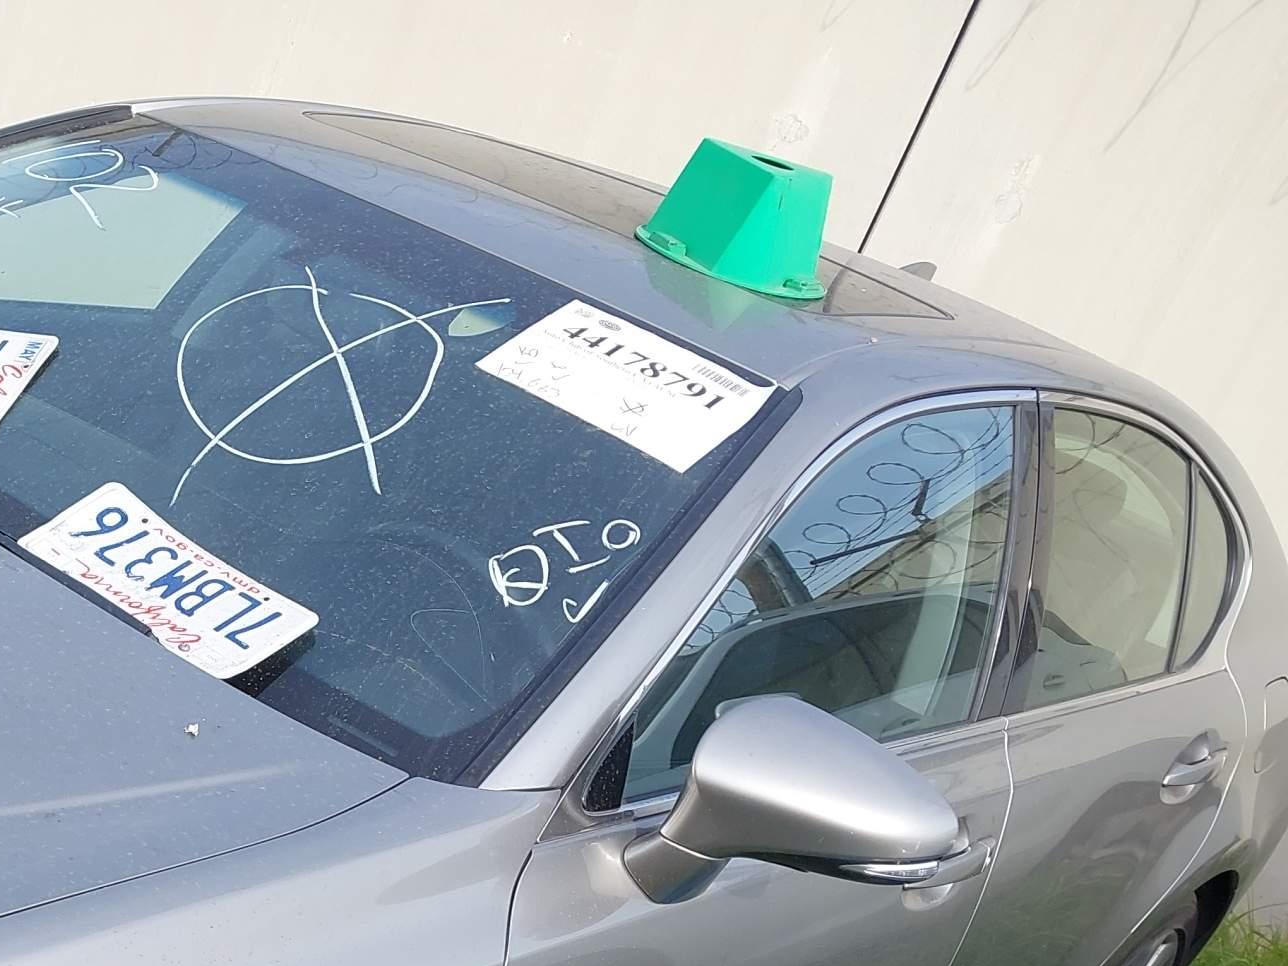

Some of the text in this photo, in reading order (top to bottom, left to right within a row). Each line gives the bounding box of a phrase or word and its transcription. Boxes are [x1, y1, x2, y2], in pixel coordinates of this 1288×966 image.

[18, 340, 44, 362] MAY
[563, 326, 726, 410] 44178791
[69, 506, 283, 650] 7LBM376
[75, 557, 203, 647] California
[151, 526, 262, 596] dmv.ca.gov
